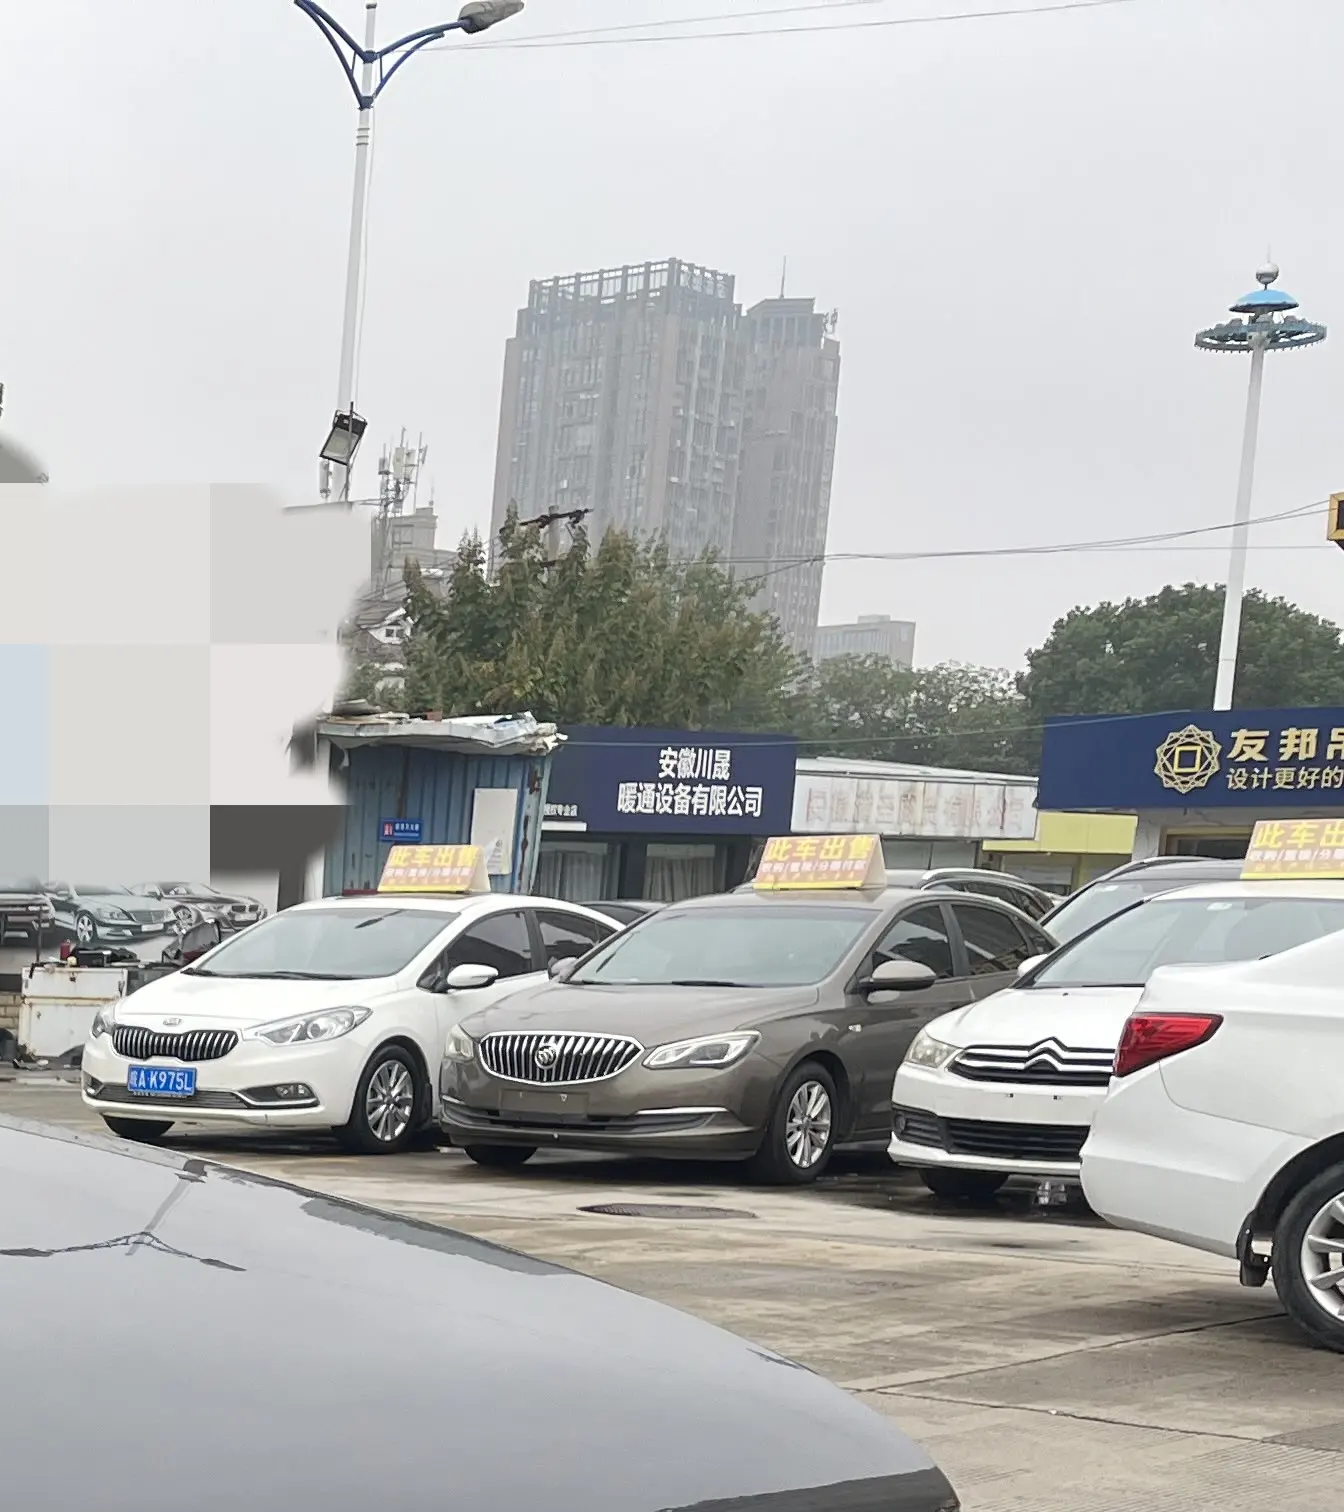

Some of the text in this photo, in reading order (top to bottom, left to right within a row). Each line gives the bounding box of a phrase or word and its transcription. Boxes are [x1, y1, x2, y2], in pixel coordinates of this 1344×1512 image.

[659, 747, 731, 781] 安徽川晟
[1226, 765, 1344, 790] 设计更好的
[617, 782, 763, 818] 暖通设备有限公司
[765, 835, 874, 861] 此车出售
